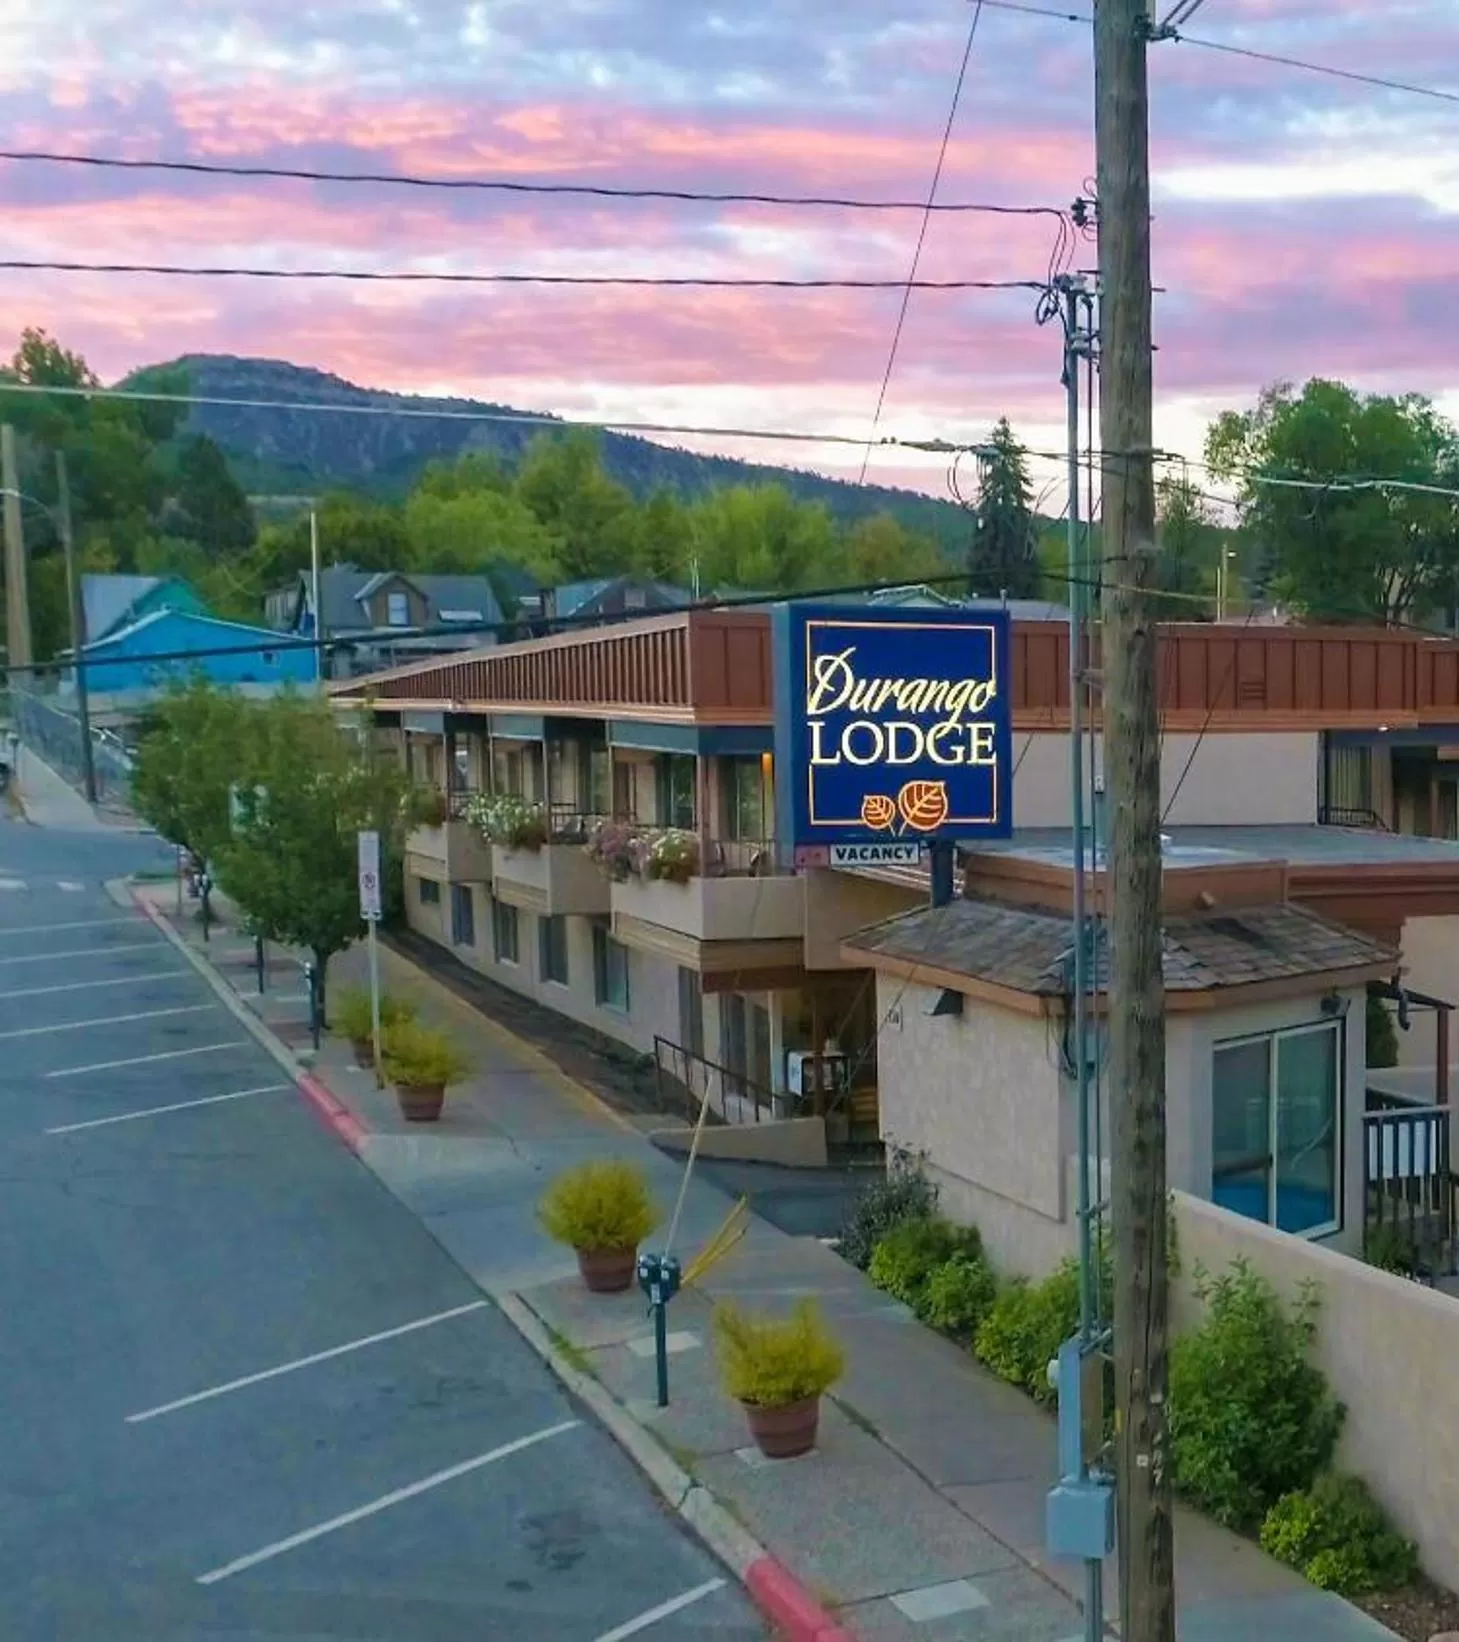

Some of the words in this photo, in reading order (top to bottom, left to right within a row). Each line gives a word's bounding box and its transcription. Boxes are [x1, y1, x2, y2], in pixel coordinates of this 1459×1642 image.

[806, 646, 998, 738] Durango
[807, 720, 998, 766] LODGE
[836, 847, 914, 861] VACANCY
